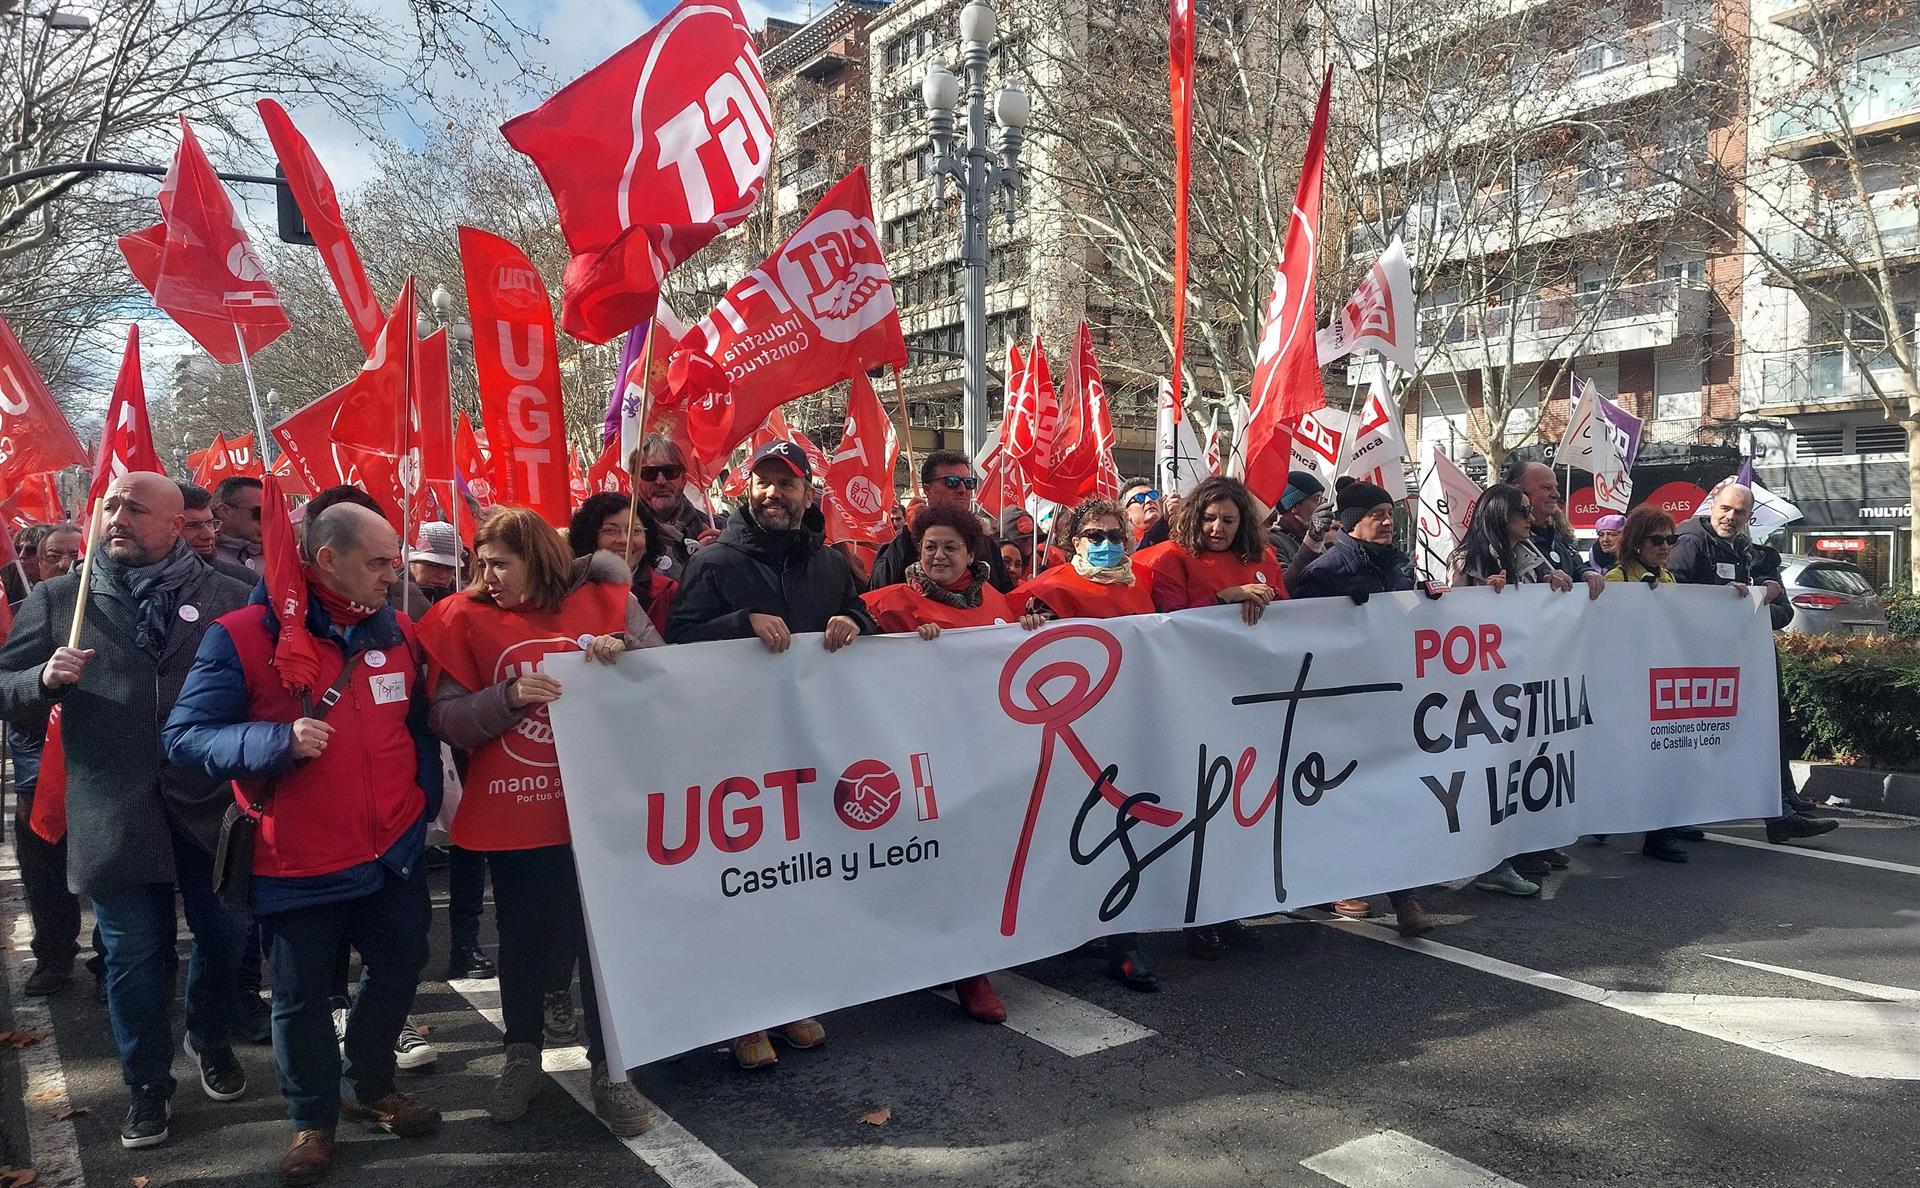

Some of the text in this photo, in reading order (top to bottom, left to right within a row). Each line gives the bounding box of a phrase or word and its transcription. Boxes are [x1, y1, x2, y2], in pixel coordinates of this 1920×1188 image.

[497, 266, 539, 294] UGT
[497, 320, 551, 504] UGT
[1575, 504, 1601, 514] GAES
[1662, 501, 1691, 512] GAES
[1415, 624, 1507, 678] POR
[1655, 677, 1736, 710] CCOO
[1413, 675, 1594, 755] CASTILLA
[1650, 720, 1731, 736] comisiones obreras
[1650, 739, 1661, 750] de
[1663, 736, 1692, 750] Castilla
[1699, 734, 1721, 746] León
[488, 775, 549, 795] mano
[999, 624, 1404, 937] Respeto
[1420, 742, 1577, 834] Y LEÓN
[517, 793, 534, 804] Por
[536, 791, 553, 801] tus
[647, 770, 816, 865] UGT
[720, 835, 940, 898] Castilla y León
